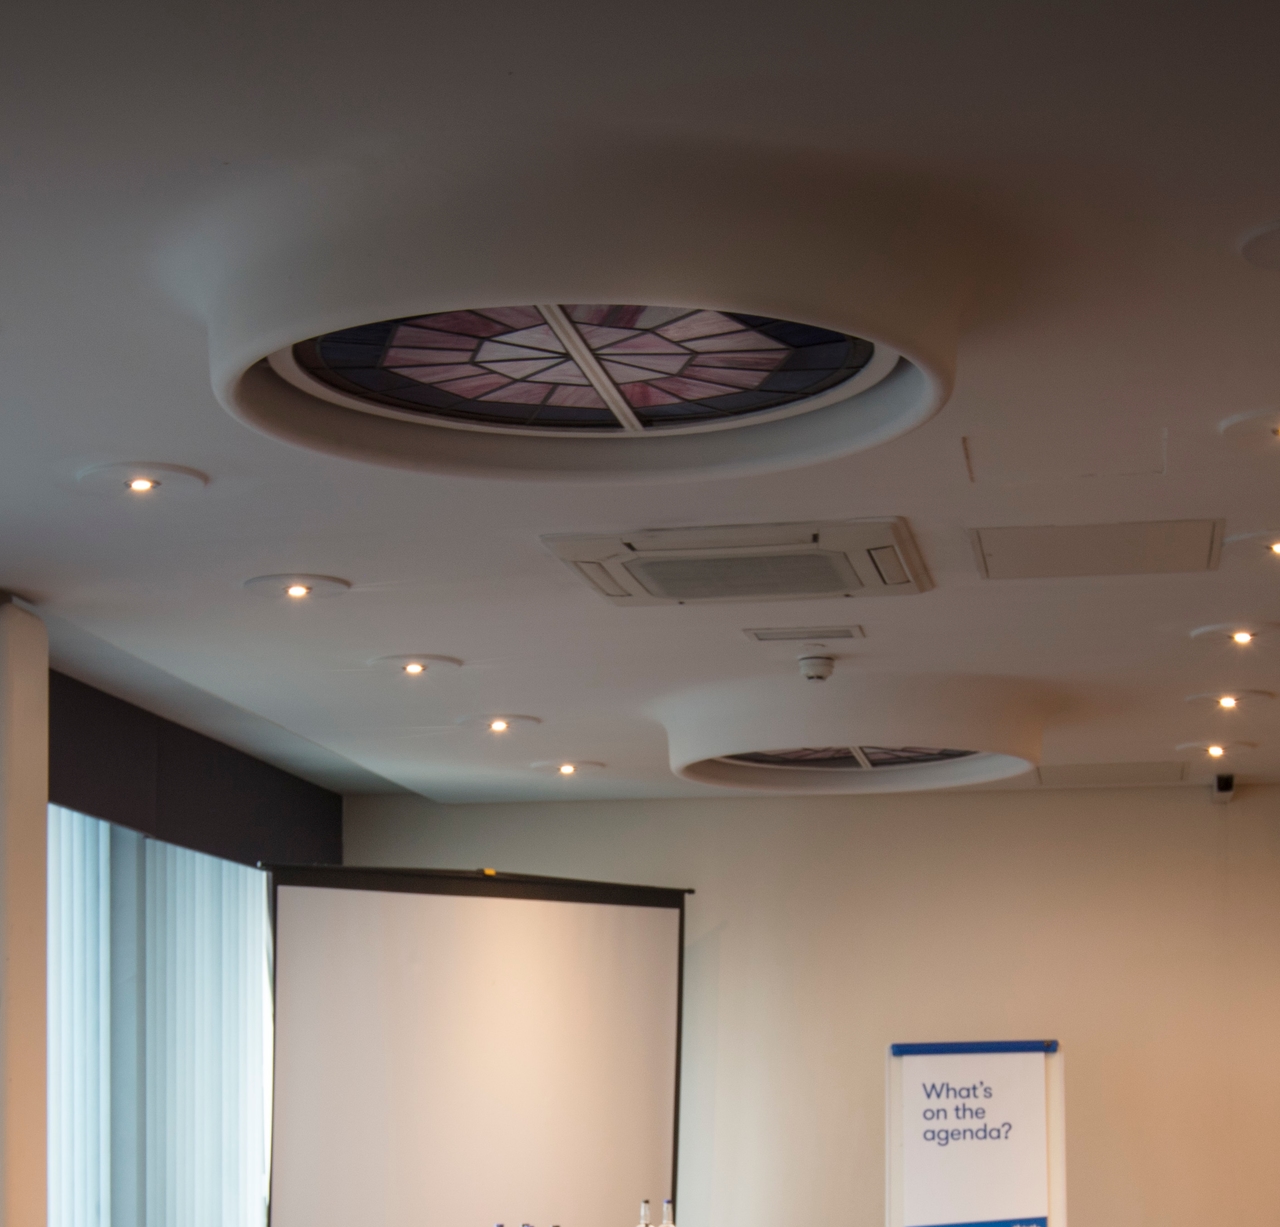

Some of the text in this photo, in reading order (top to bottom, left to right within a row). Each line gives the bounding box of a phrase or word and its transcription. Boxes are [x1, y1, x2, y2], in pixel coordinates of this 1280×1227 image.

[922, 1081, 993, 1100] What's
[923, 1103, 986, 1120] on the
[923, 1123, 1012, 1146] agenda?
